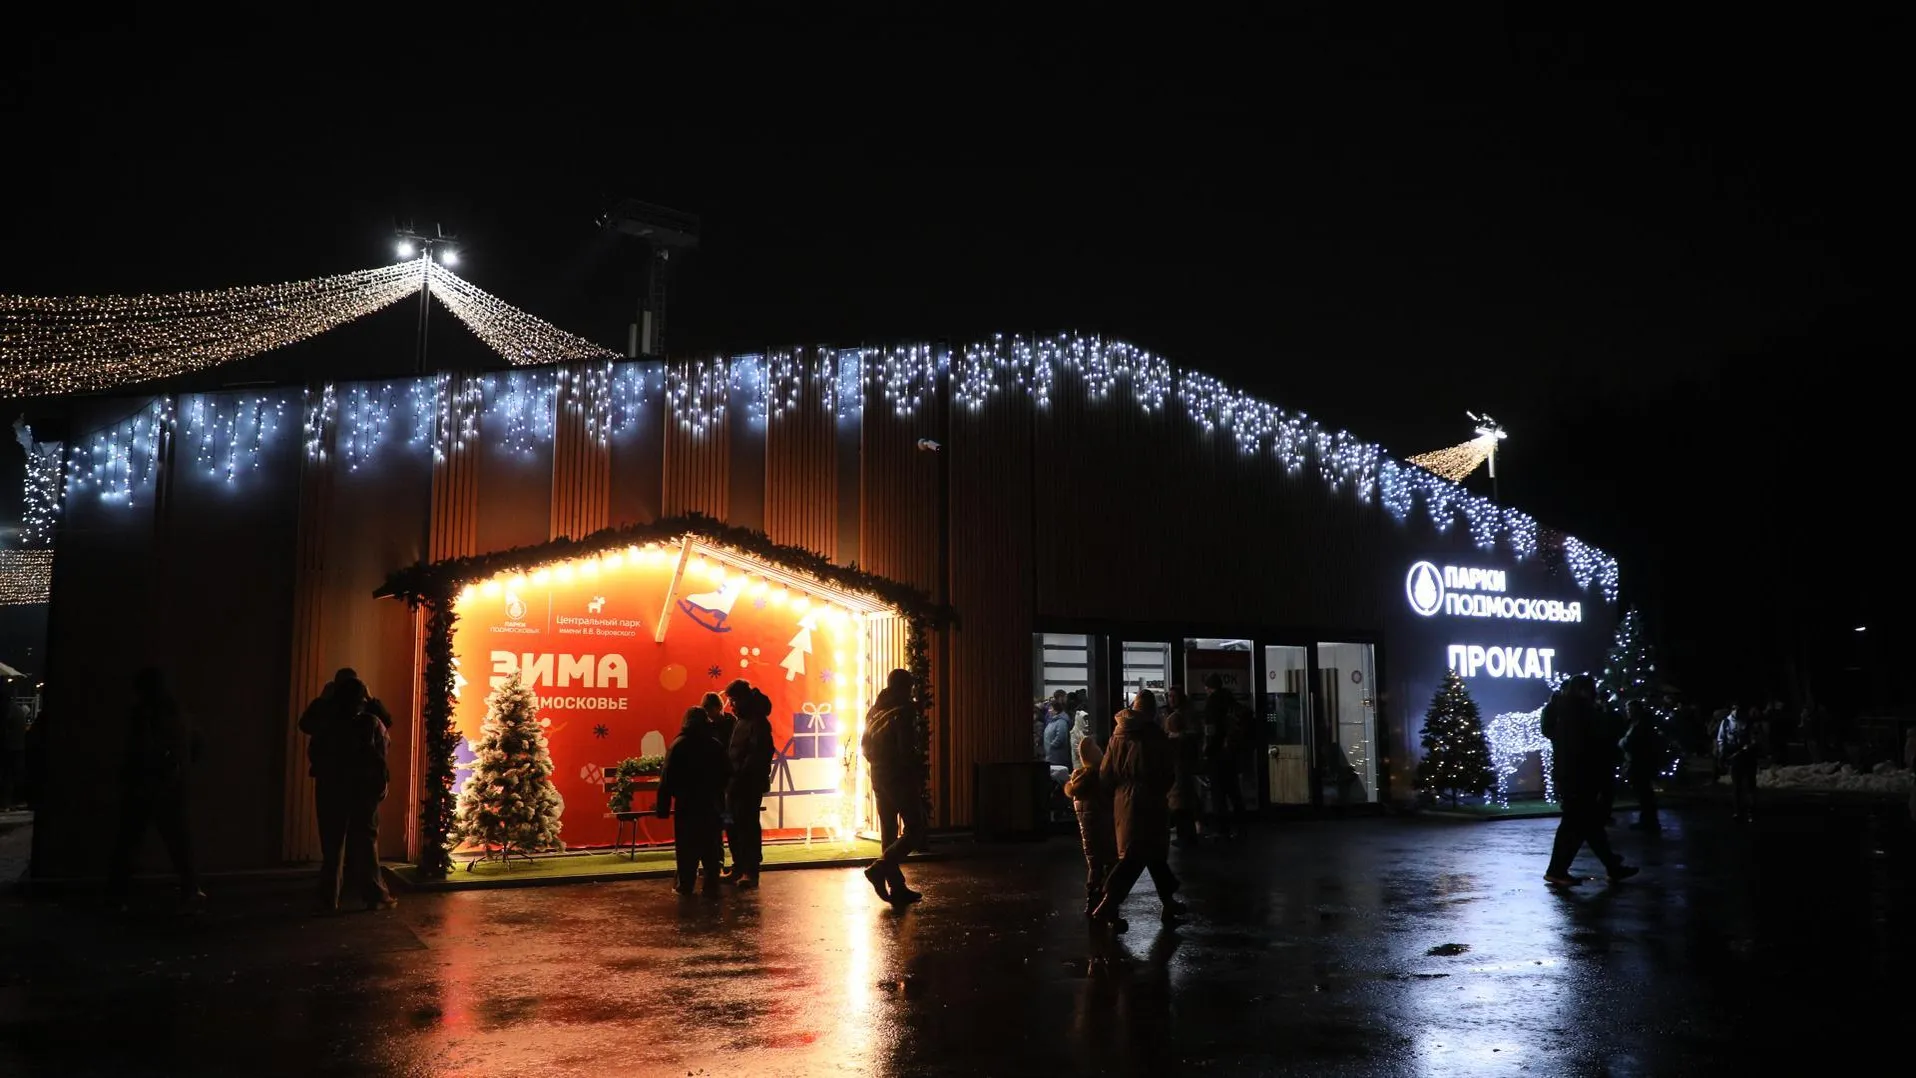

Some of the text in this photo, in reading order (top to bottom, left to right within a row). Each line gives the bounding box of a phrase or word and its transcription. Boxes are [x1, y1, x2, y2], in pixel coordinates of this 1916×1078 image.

[1444, 565, 1506, 592] ПАРКИ
[556, 615, 641, 628] Центральный парк
[1445, 593, 1582, 623] ПОДМОСКОВЬЯ
[596, 628, 636, 637] Воровского
[490, 650, 629, 688] ЗИМА
[1447, 644, 1556, 679] ПРОКАТ
